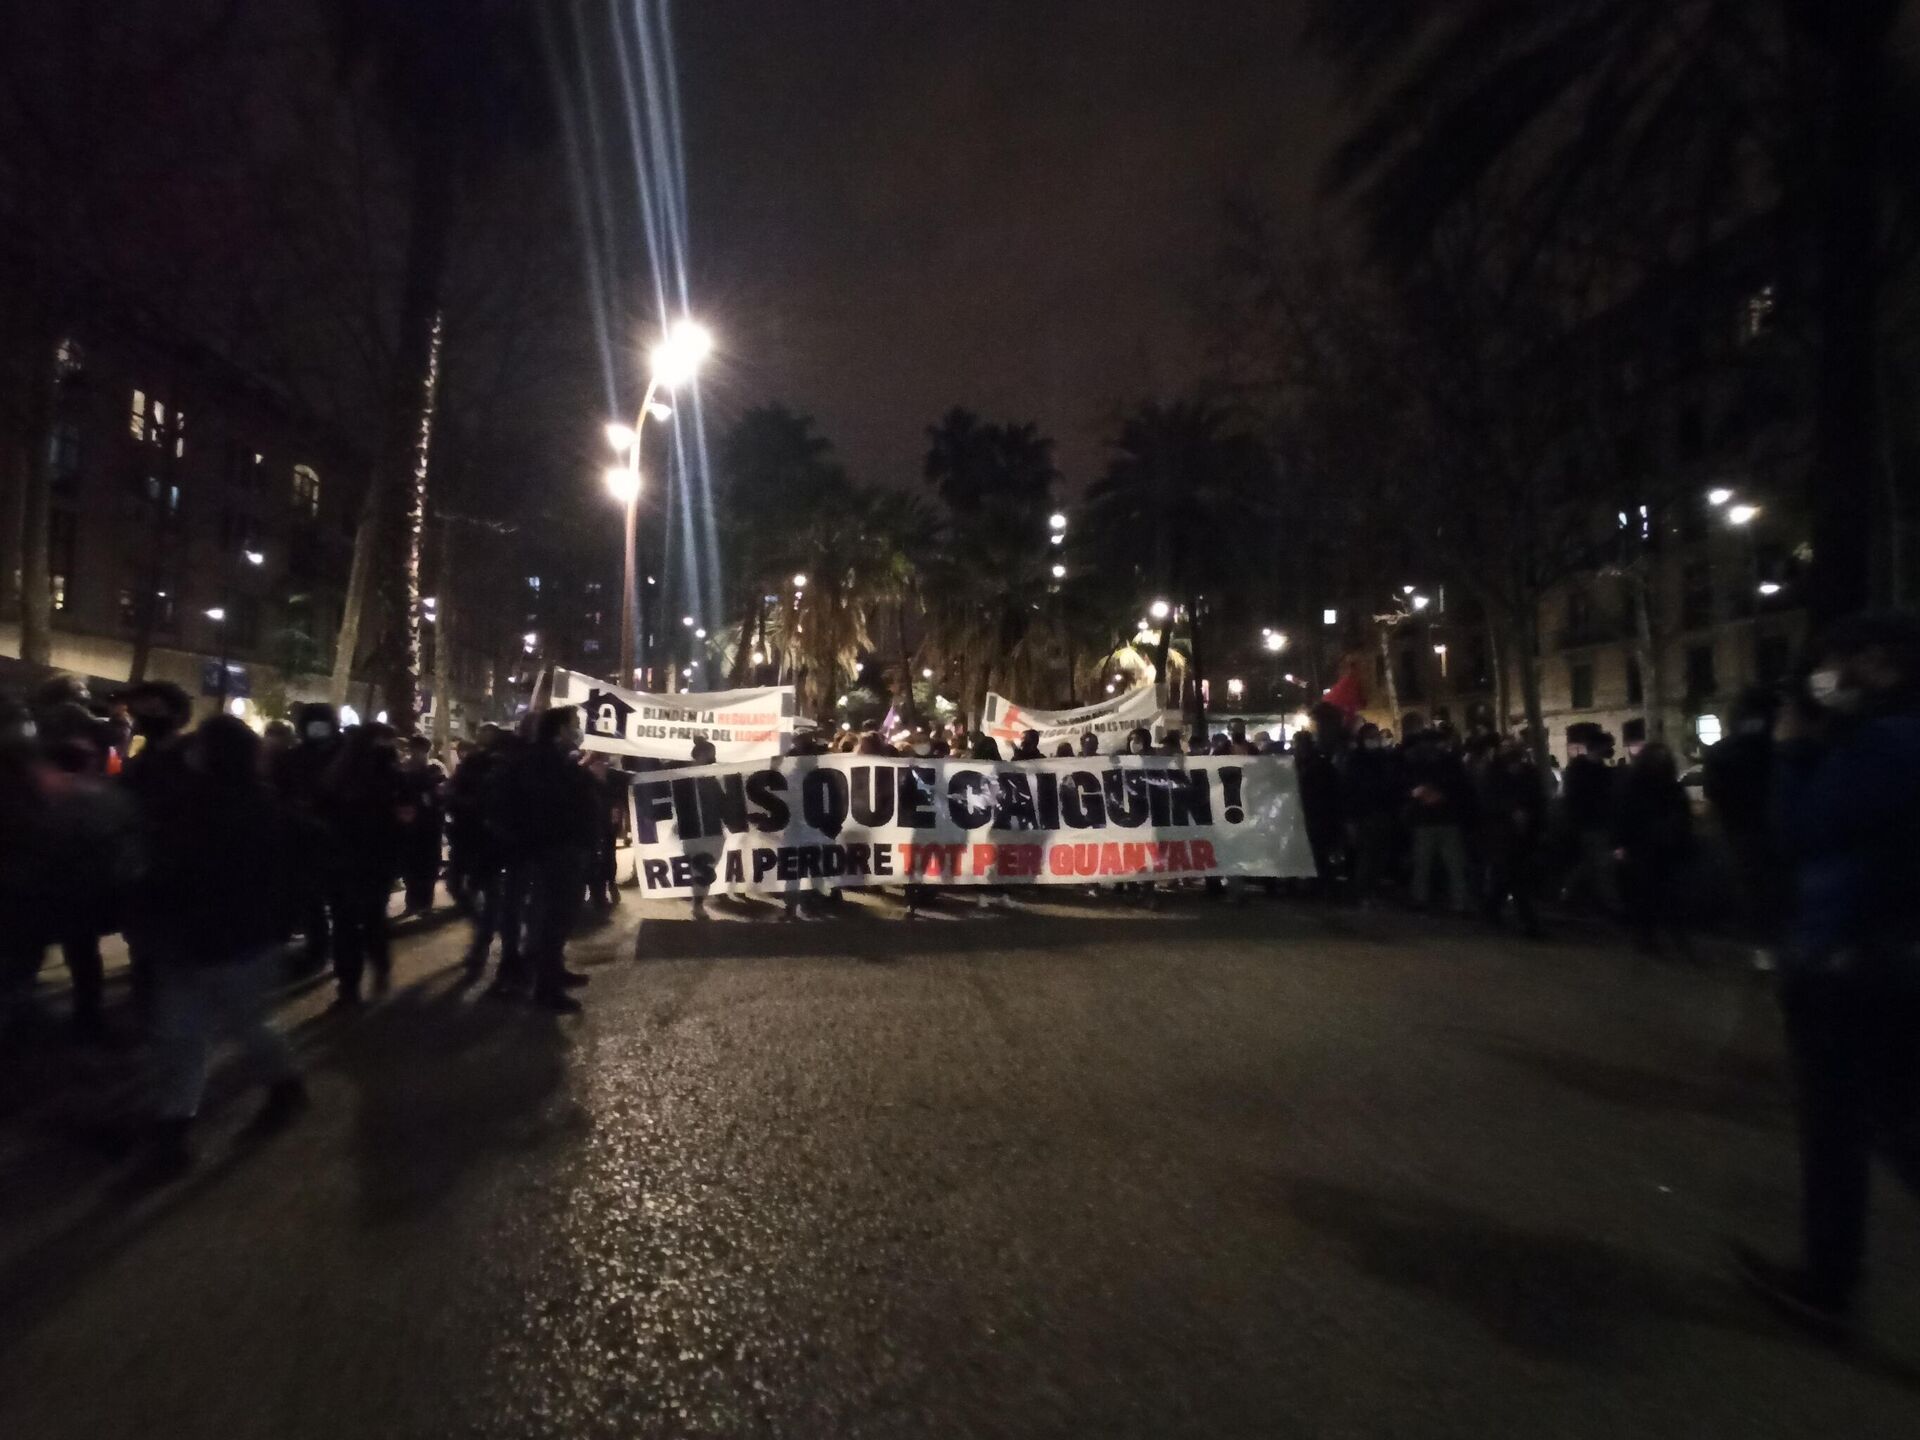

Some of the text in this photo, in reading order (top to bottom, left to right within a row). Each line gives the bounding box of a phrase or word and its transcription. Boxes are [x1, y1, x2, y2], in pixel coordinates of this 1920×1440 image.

[637, 725, 666, 739] DELS
[711, 729, 732, 742] DEL
[701, 712, 714, 723] LA
[633, 769, 791, 844] FINS
[802, 766, 936, 840] QUE
[643, 839, 1218, 889] RES A PERDRE TOT PER GUANYAR
